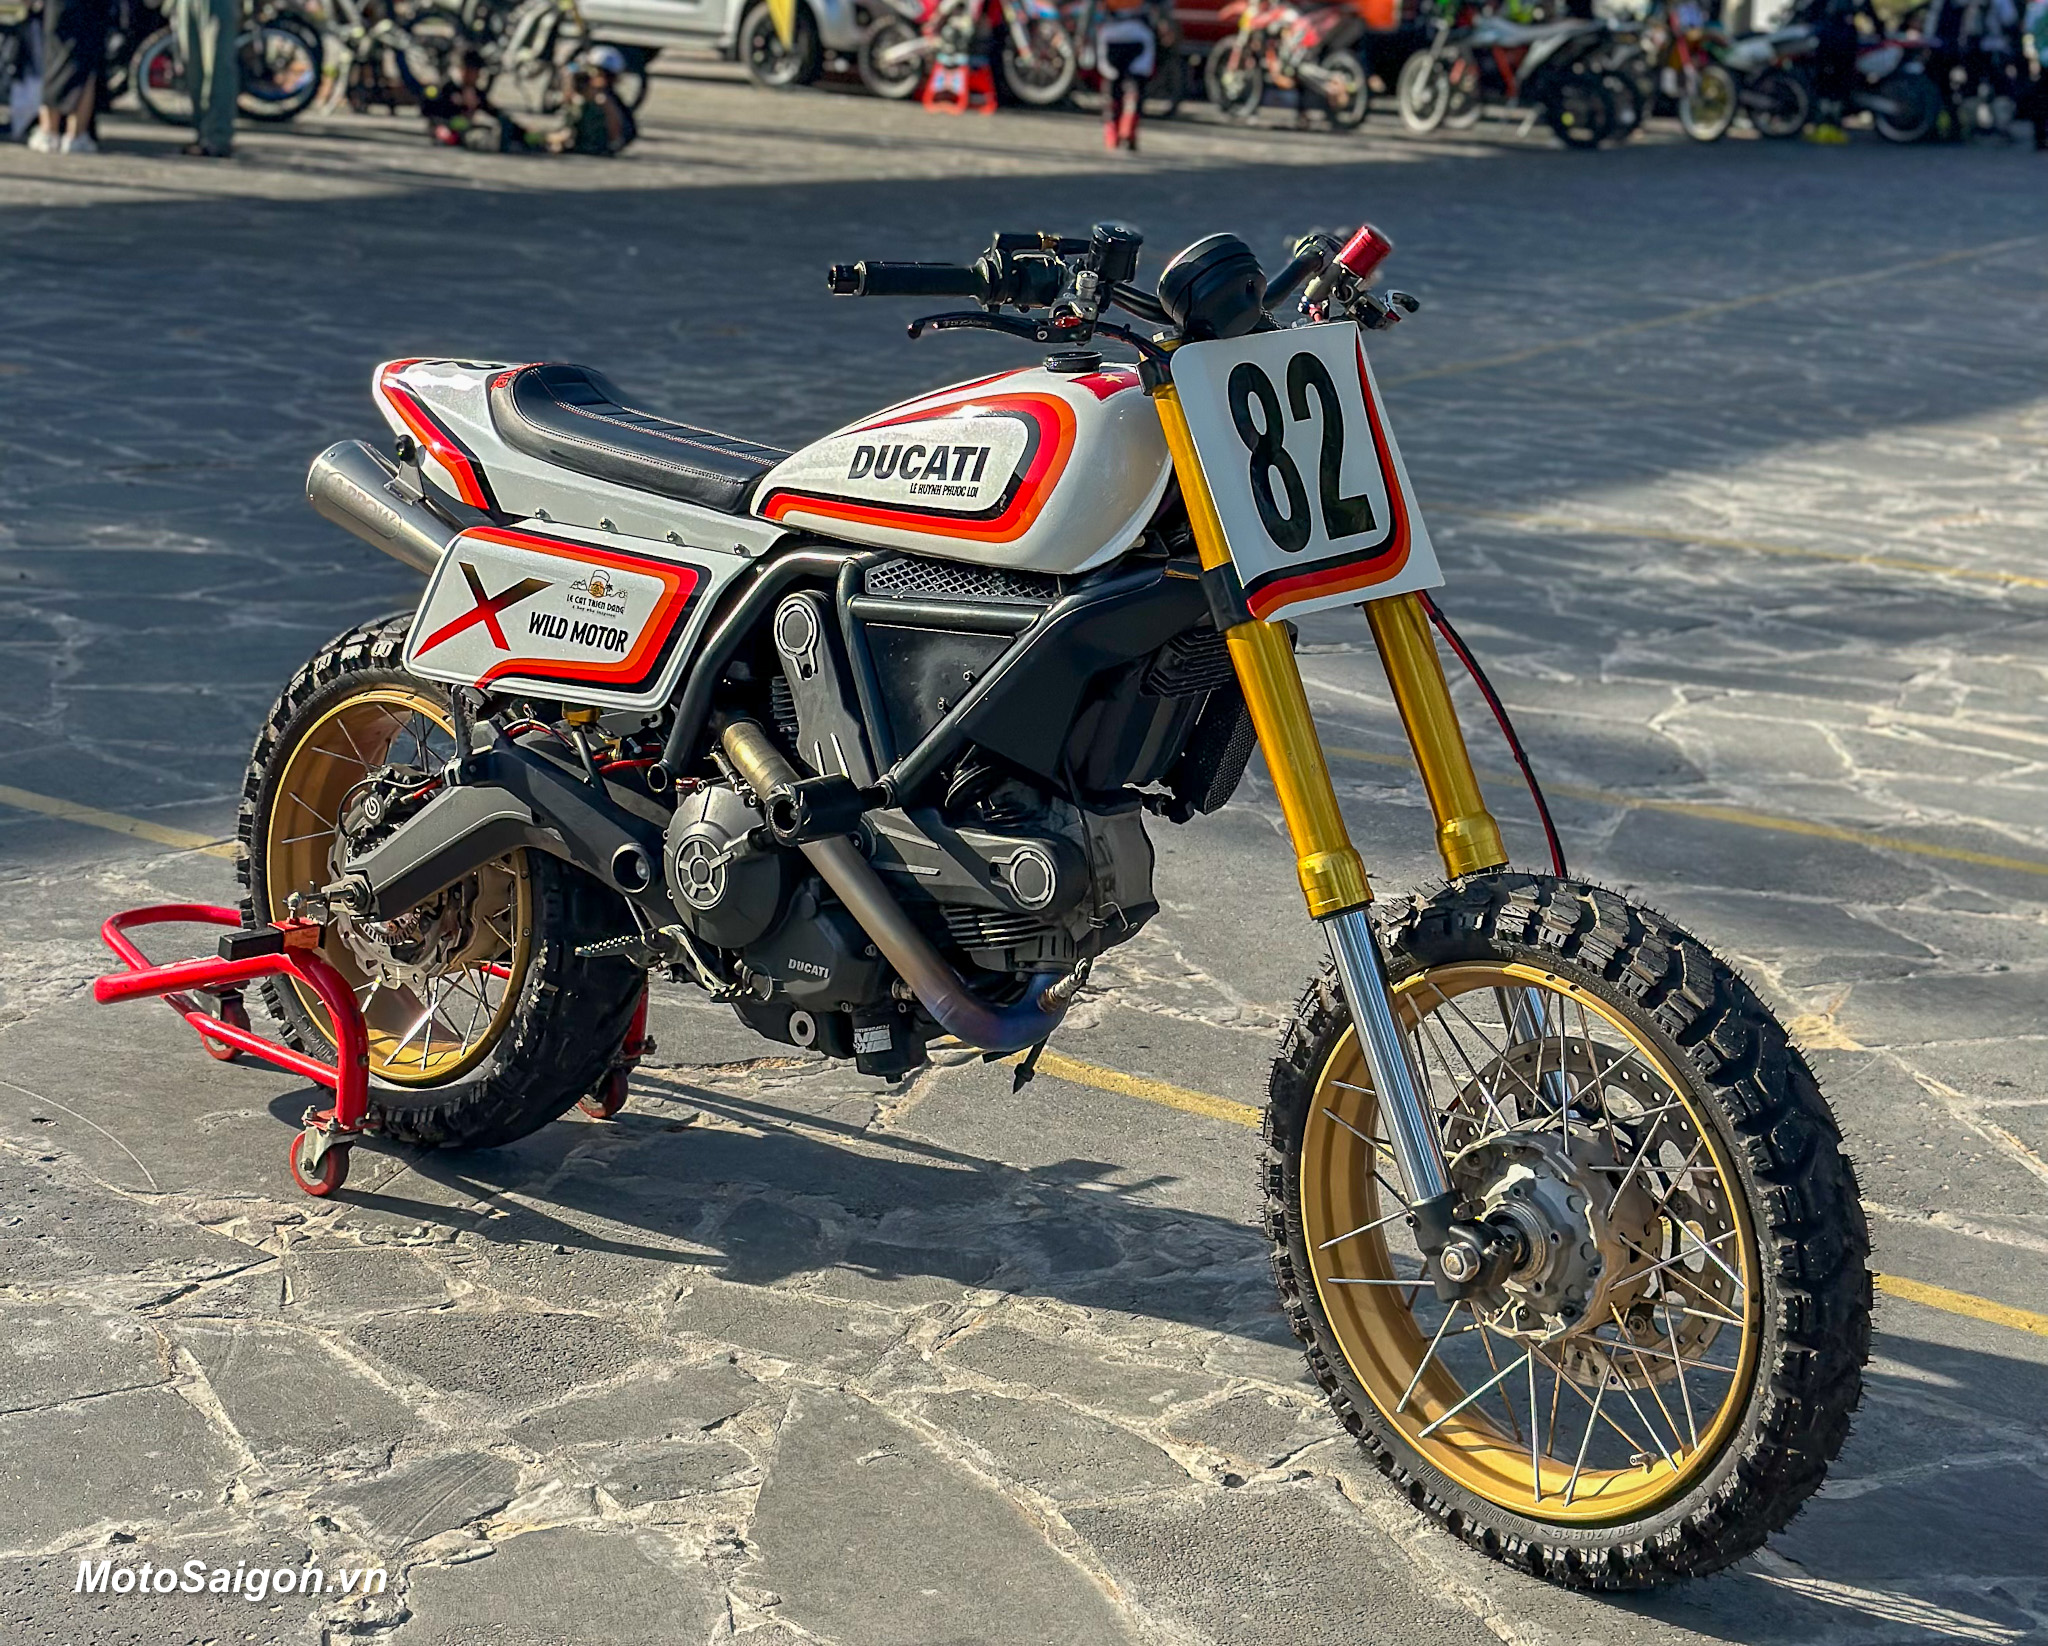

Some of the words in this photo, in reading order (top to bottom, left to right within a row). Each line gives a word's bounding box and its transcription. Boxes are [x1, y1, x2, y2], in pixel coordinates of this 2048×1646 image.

[848, 444, 991, 482] DUCATI
[1227, 351, 1377, 553] 82
[909, 482, 918, 494] LE
[528, 611, 568, 640] WILD
[570, 620, 629, 653] MOTOR
[788, 958, 829, 979] DUCATI
